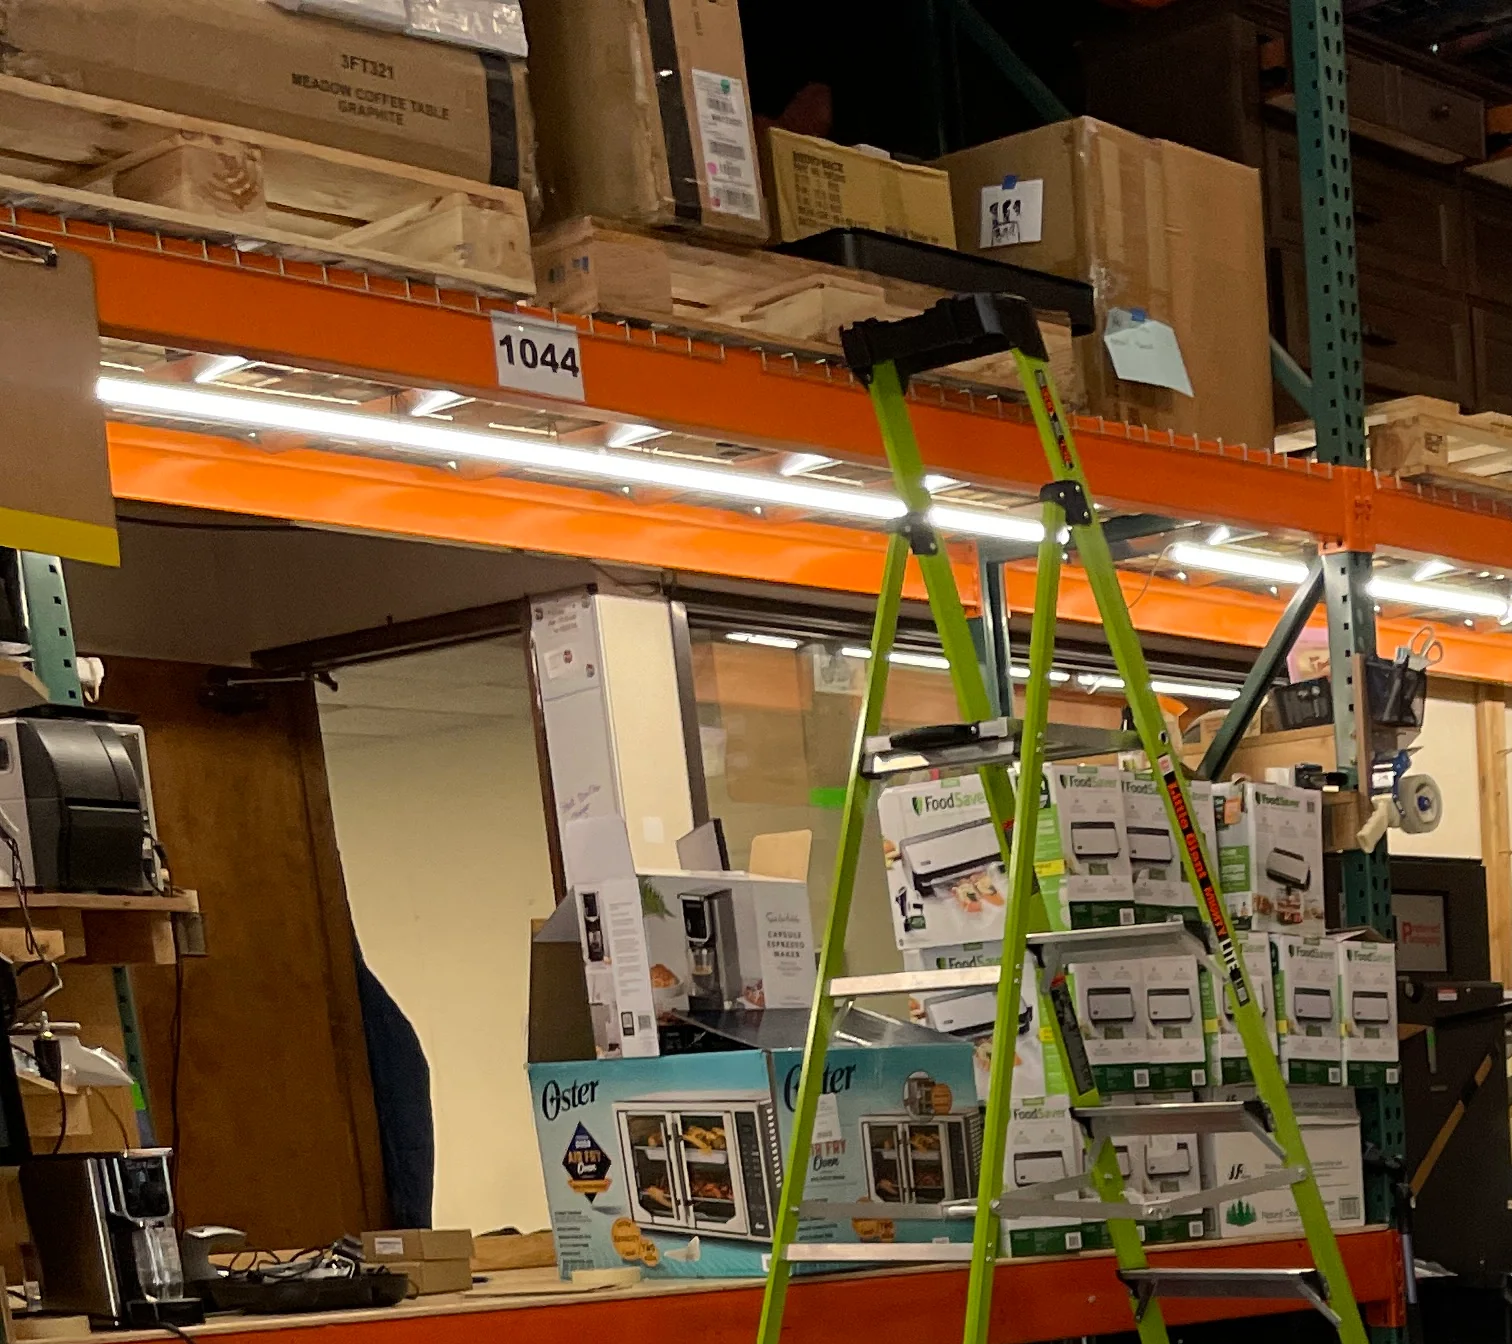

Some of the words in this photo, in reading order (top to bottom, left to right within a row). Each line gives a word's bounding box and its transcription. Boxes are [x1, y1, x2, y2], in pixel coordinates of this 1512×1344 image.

[338, 100, 404, 126] GRAPHITE
[355, 87, 407, 111] COFFEE
[410, 99, 450, 121] TABLE
[499, 334, 580, 378] 1044
[924, 791, 989, 813] FoodSave
[1167, 781, 1190, 829] Little
[1184, 833, 1208, 880] Giant
[541, 1079, 600, 1121] Oster
